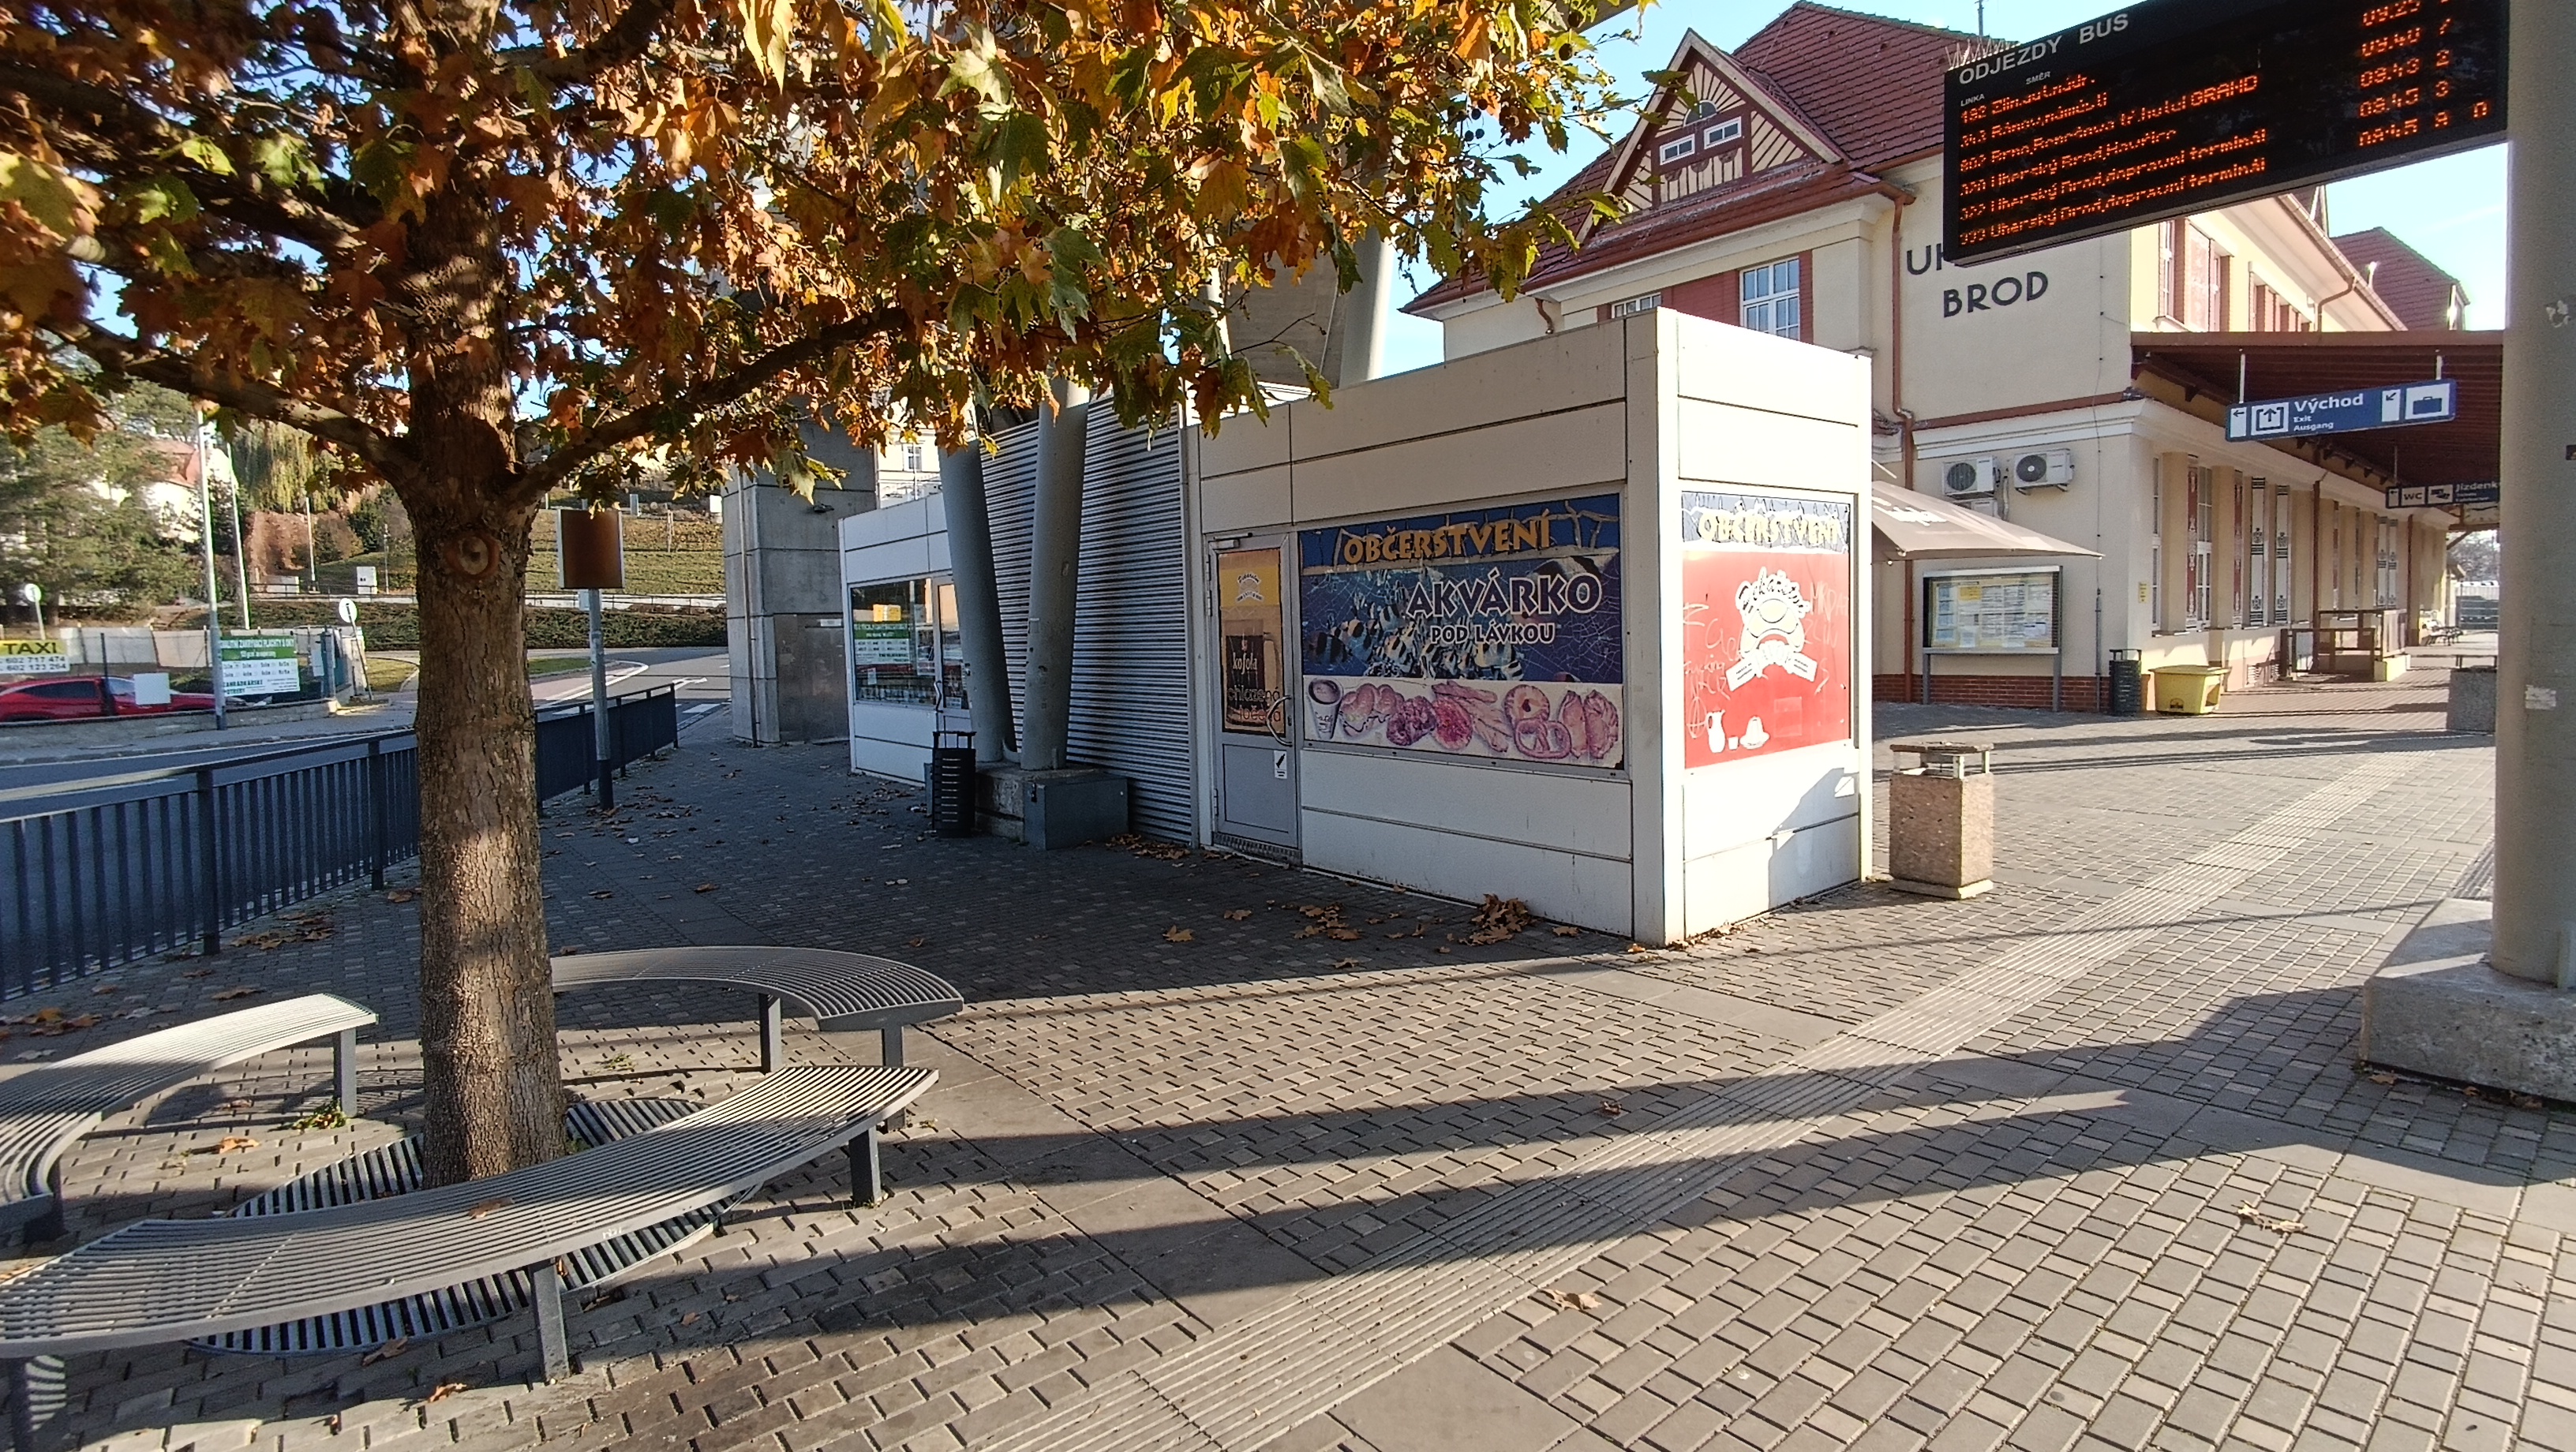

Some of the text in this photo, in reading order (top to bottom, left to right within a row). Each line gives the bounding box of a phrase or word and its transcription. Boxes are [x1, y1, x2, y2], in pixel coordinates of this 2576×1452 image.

[1959, 13, 2129, 84] ODJEZDY BUS
[2026, 71, 2050, 84] SMĚR
[1960, 94, 1985, 107] LINKA
[2191, 75, 2257, 107] GRAND
[1944, 271, 2048, 318] BROD
[2294, 393, 2364, 414] Východ
[2293, 422, 2334, 432] Ausgang
[1344, 508, 1551, 563] OBČERSTVENÍ
[1406, 567, 1602, 618] AKVÁRKO
[1432, 619, 1556, 645] POD LÁVKOU
[3, 642, 57, 654] TAXI
[1232, 653, 1257, 675] kofola
[1228, 685, 1281, 702] chlazená
